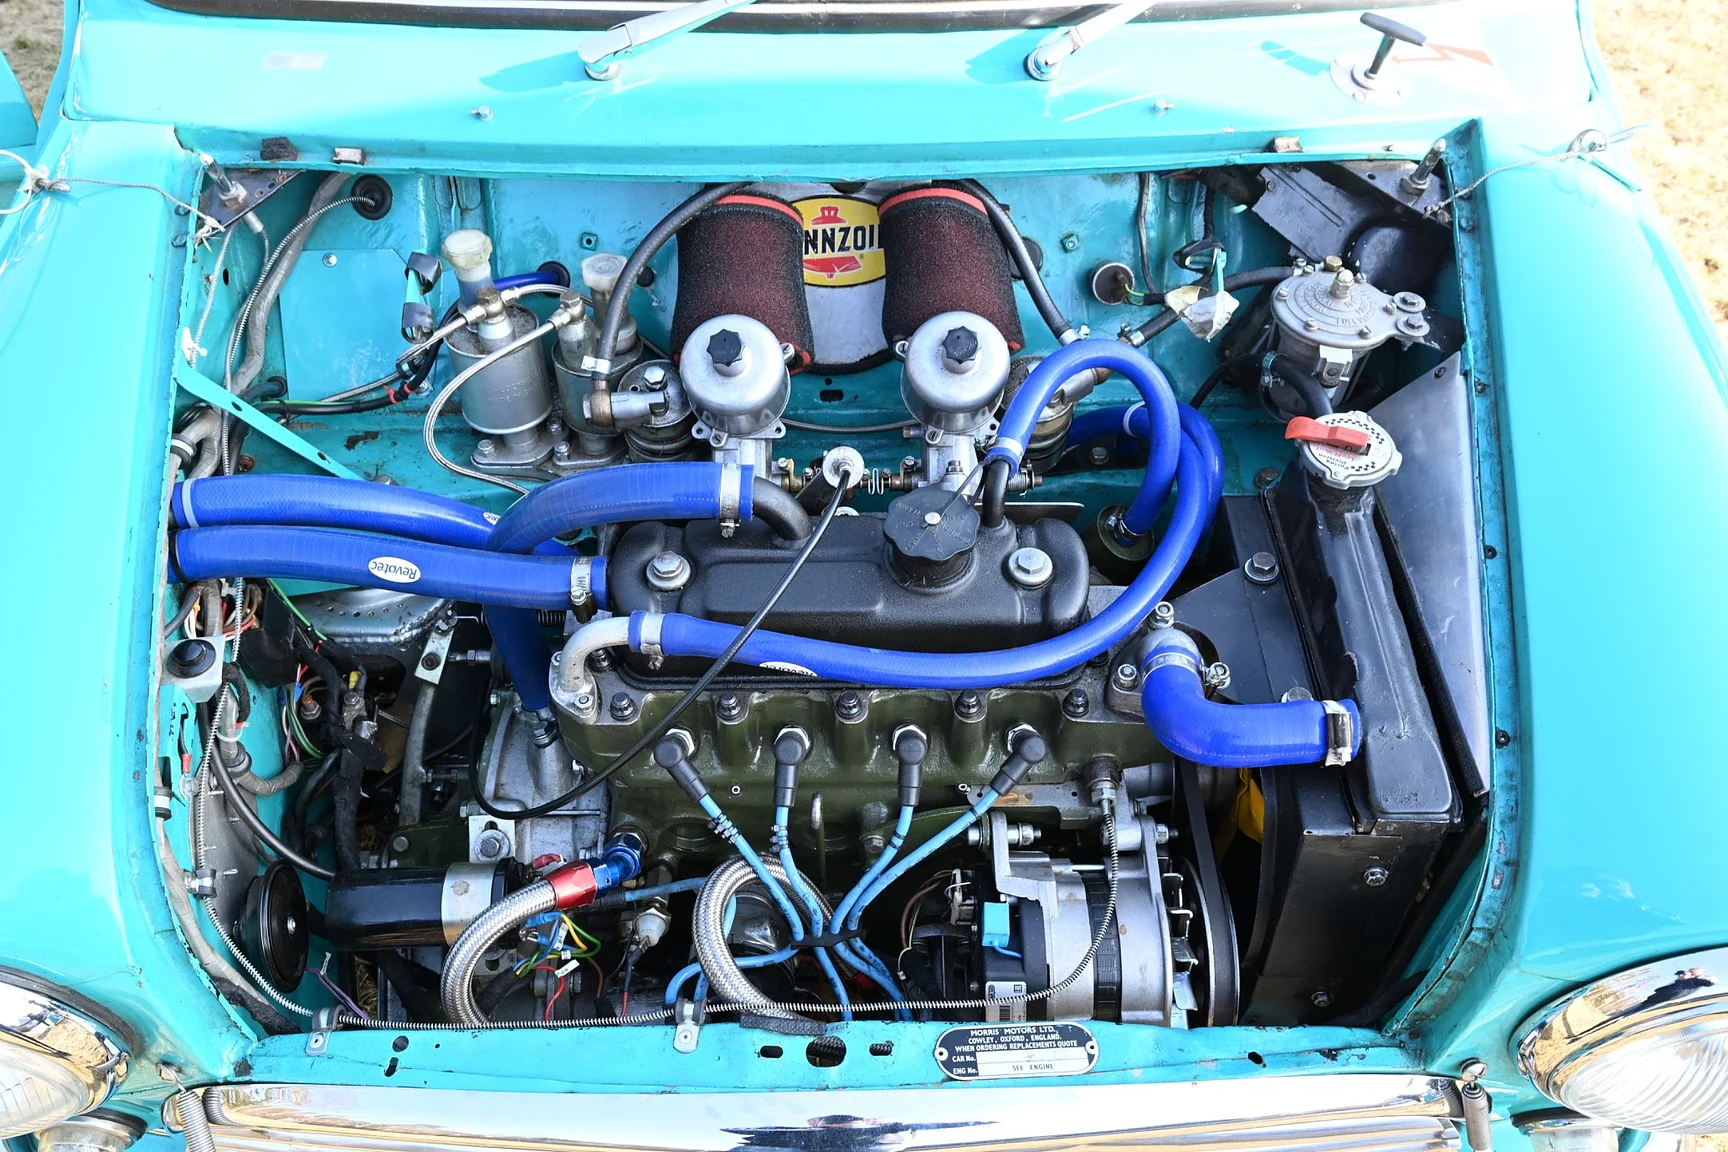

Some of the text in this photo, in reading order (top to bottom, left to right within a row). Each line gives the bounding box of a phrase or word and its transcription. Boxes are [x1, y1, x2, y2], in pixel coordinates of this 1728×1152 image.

[370, 561, 417, 580] Revotec
[970, 1025, 1056, 1036] MORRIS MOTORS LTD.
[1030, 1033, 1062, 1041] ENGLAND.
[954, 1039, 1078, 1053] WHEN ORDERING REPLACEMENTS QUOTE
[1029, 1063, 1054, 1071] ENGINE
